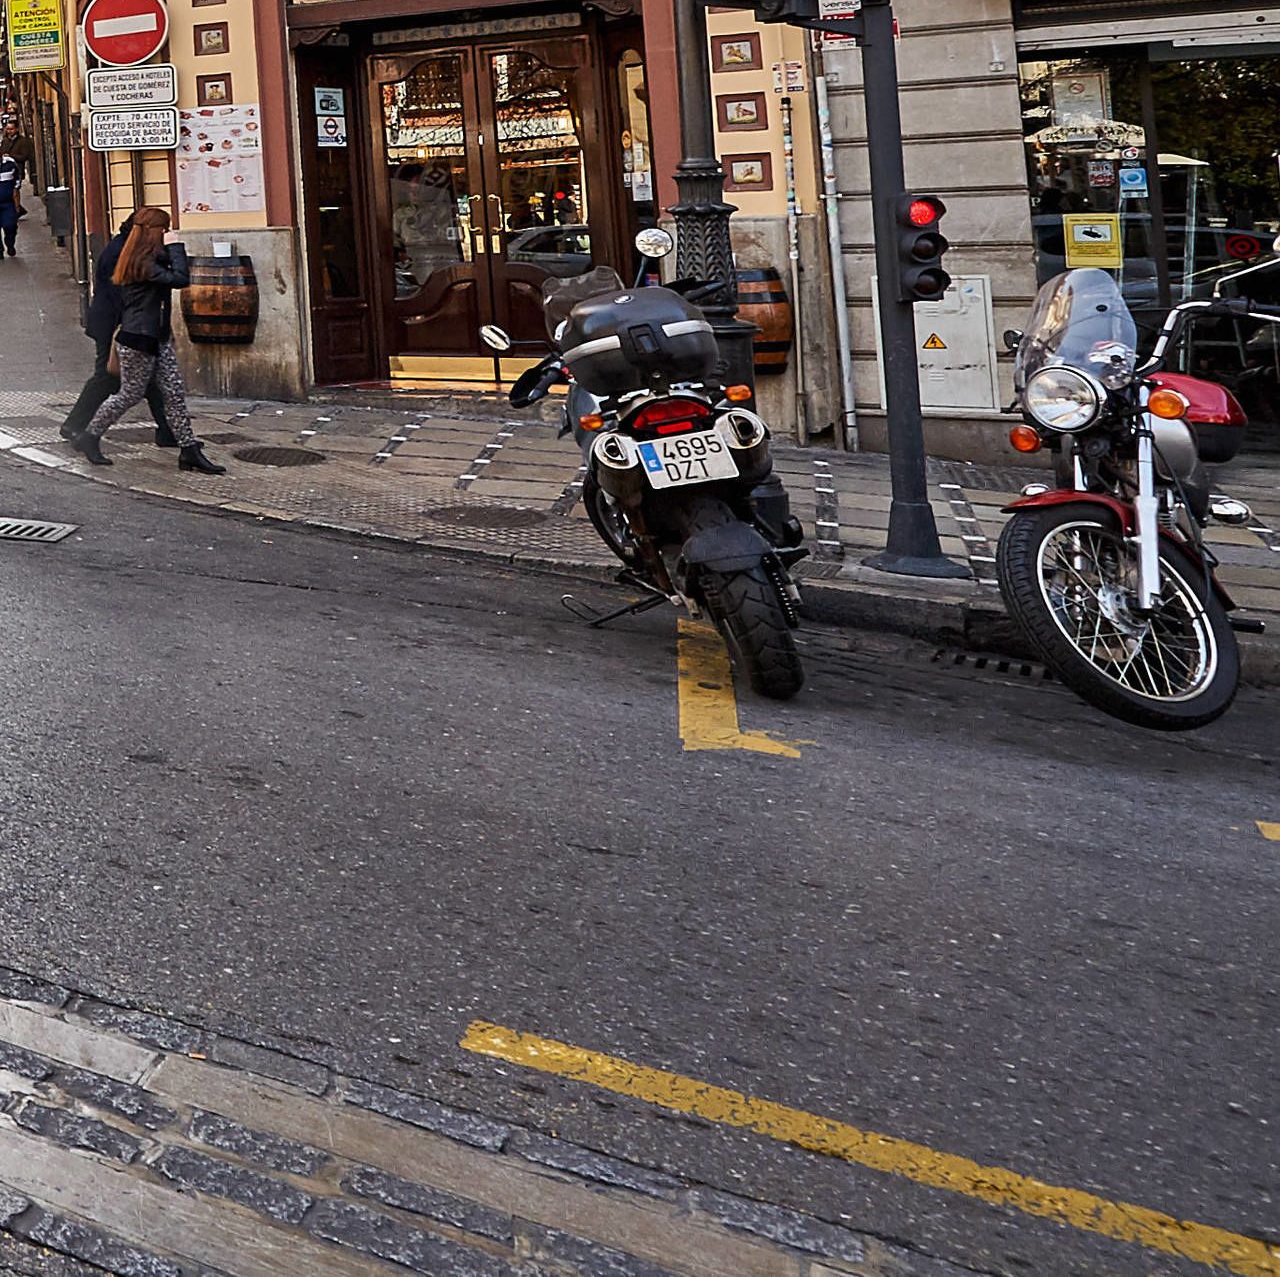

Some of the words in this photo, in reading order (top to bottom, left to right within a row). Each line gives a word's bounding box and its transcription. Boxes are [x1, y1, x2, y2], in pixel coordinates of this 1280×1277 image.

[92, 75, 117, 83] EXCEPTO
[118, 73, 140, 82] ACCESO
[145, 70, 171, 79] HOTELES
[93, 85, 102, 93] DE
[103, 84, 127, 93] CUESTA
[128, 83, 137, 91] DE
[116, 91, 154, 101] COCHERAS
[95, 122, 126, 131] EXCEPTO
[127, 121, 160, 130] SERVICIO
[161, 120, 171, 128] DE
[95, 130, 131, 138] RECOGIDA
[132, 129, 142, 137] DE
[143, 128, 173, 136] BASURA
[97, 138, 107, 146] DE
[662, 434, 722, 460] 4695
[664, 458, 710, 482] DZT
